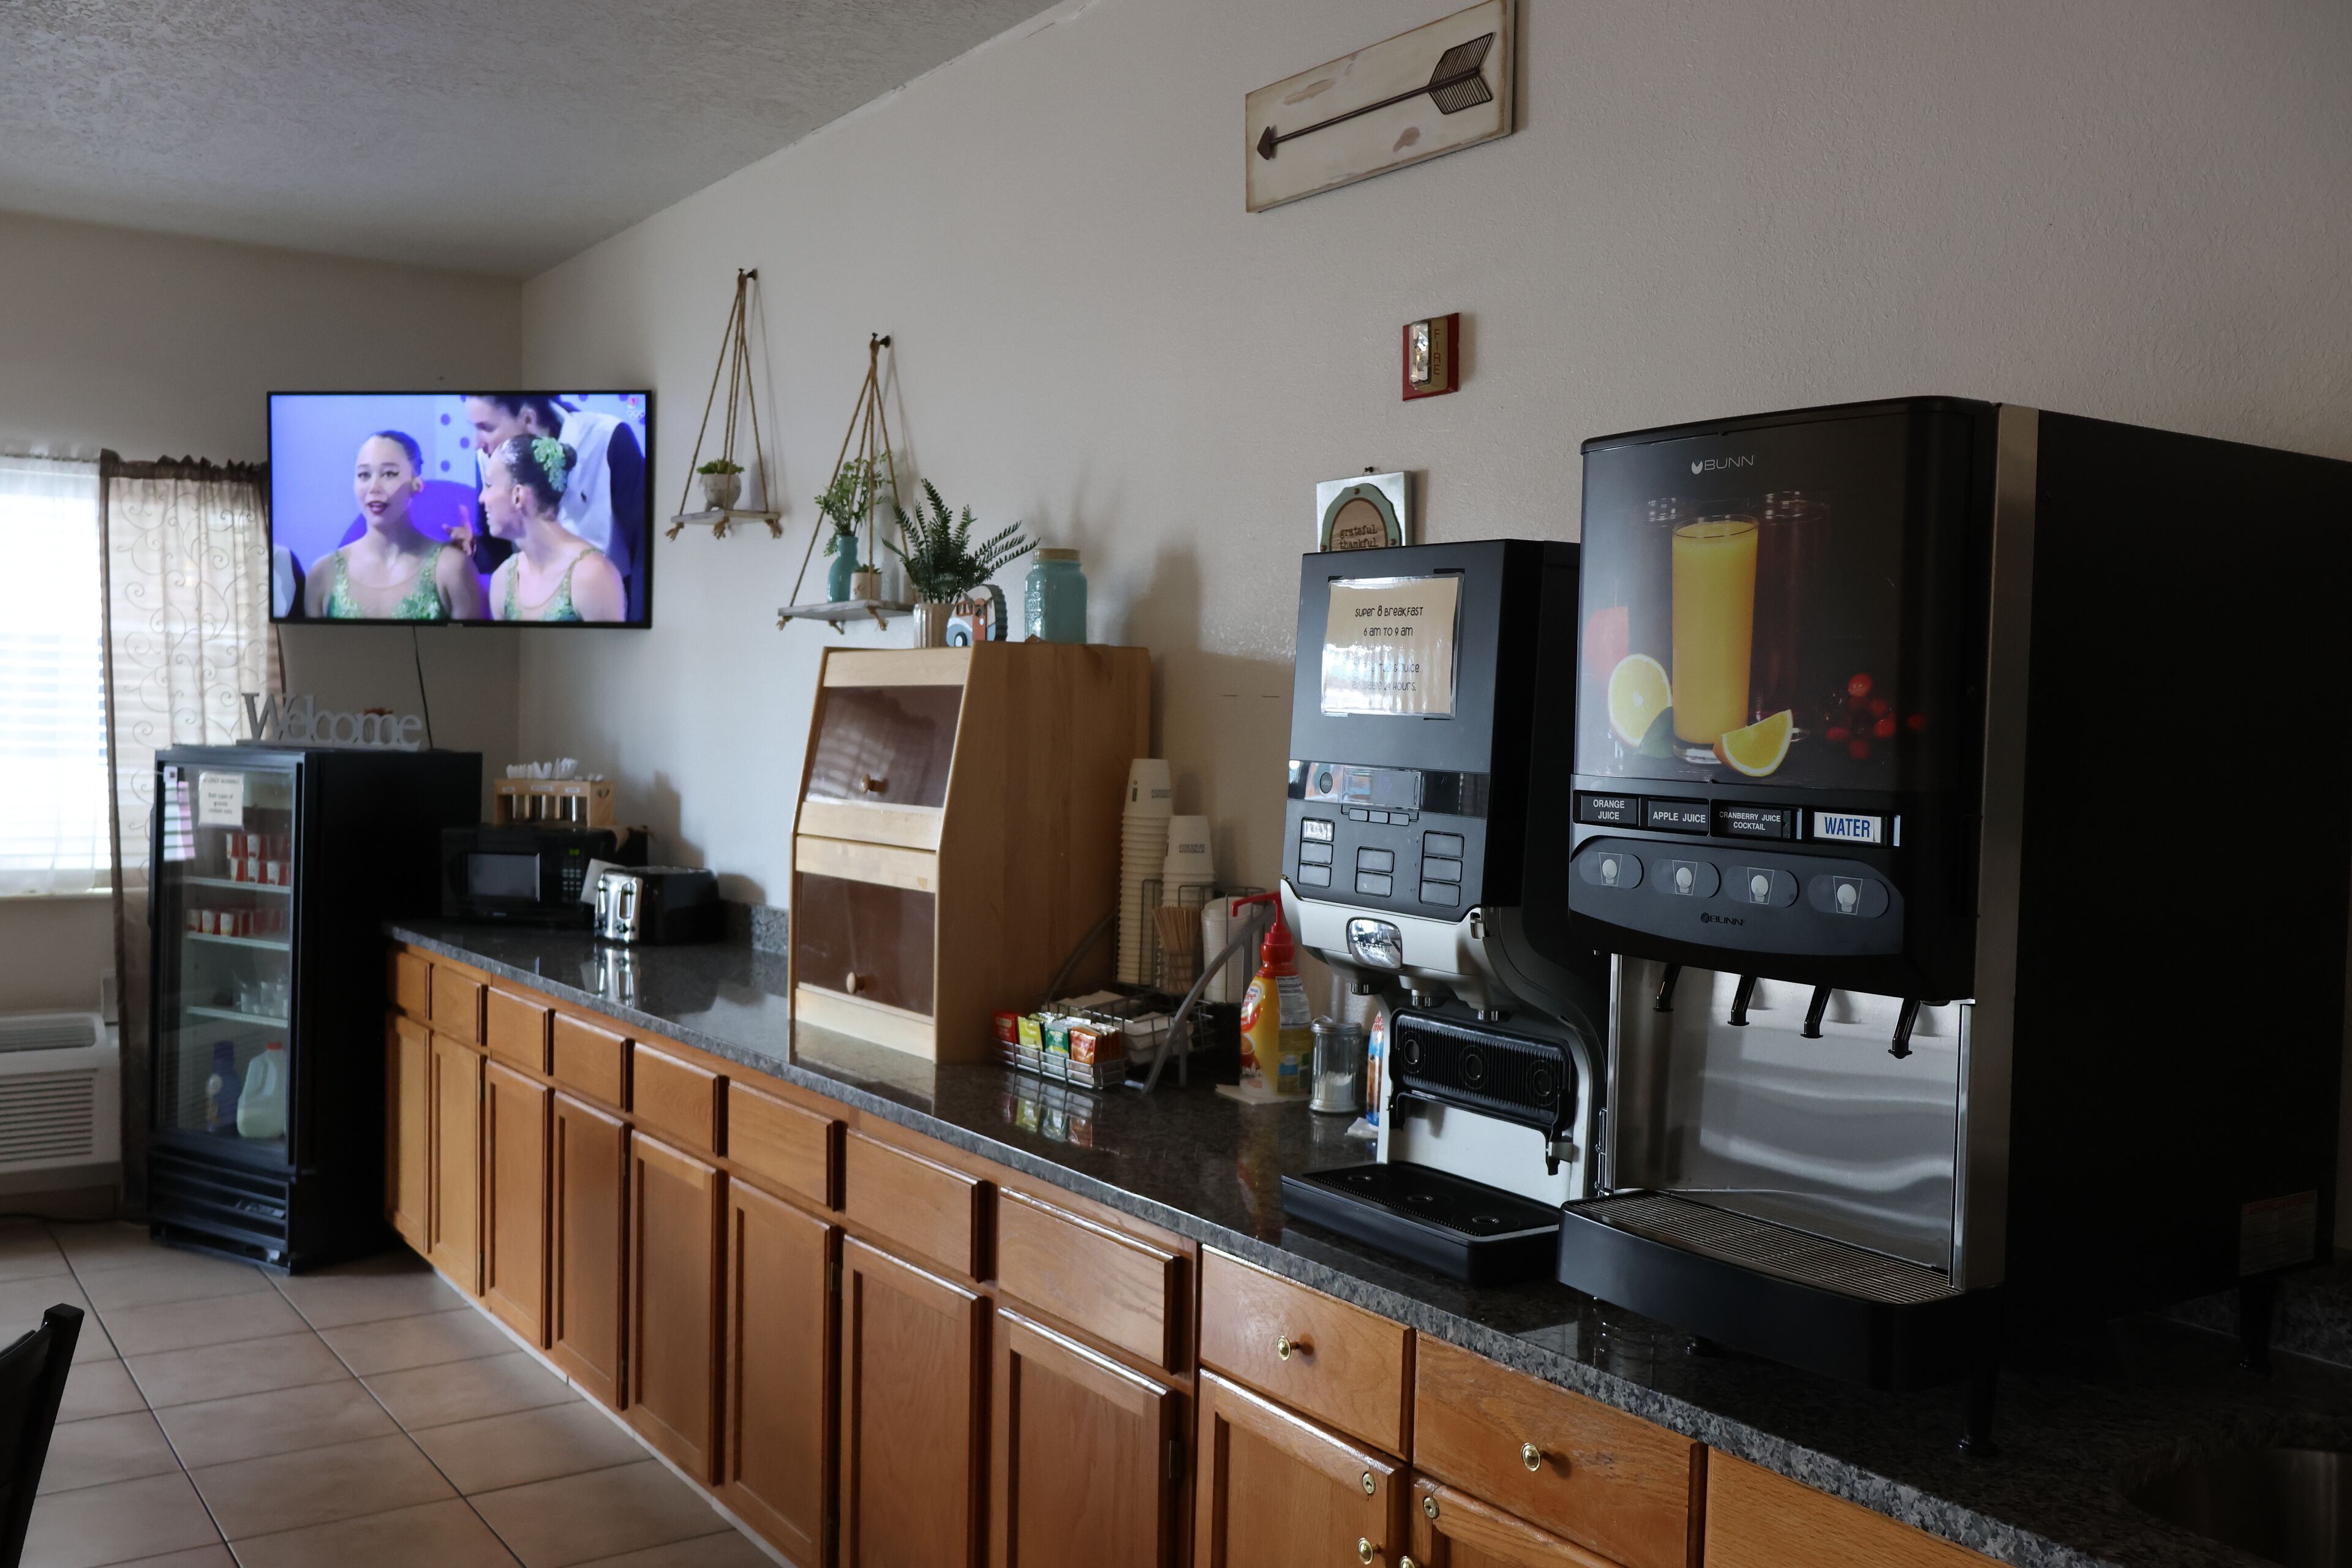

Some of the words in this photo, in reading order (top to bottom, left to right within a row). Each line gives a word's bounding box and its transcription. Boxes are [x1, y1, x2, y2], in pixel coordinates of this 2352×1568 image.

[1704, 455, 1754, 470] BUNN
[1340, 524, 1378, 539] grateful
[1340, 538, 1379, 549] thankful
[1377, 605, 1382, 617] 8
[1363, 627, 1367, 636] 6
[1369, 627, 1381, 636] am
[1395, 627, 1399, 636] 9
[1401, 627, 1413, 636] am
[241, 693, 421, 751] Welcome
[1593, 799, 1625, 809] ORANGE
[1597, 811, 1619, 820] JUICE
[1653, 811, 1679, 821] APPLE
[1682, 813, 1706, 823] JUICE
[1719, 811, 1758, 821] CRANBERRY
[1761, 814, 1781, 823] JUICE
[1733, 821, 1766, 831] COCKTAIL
[1824, 816, 1871, 838] WATER
[1709, 915, 1743, 926] BUNN
